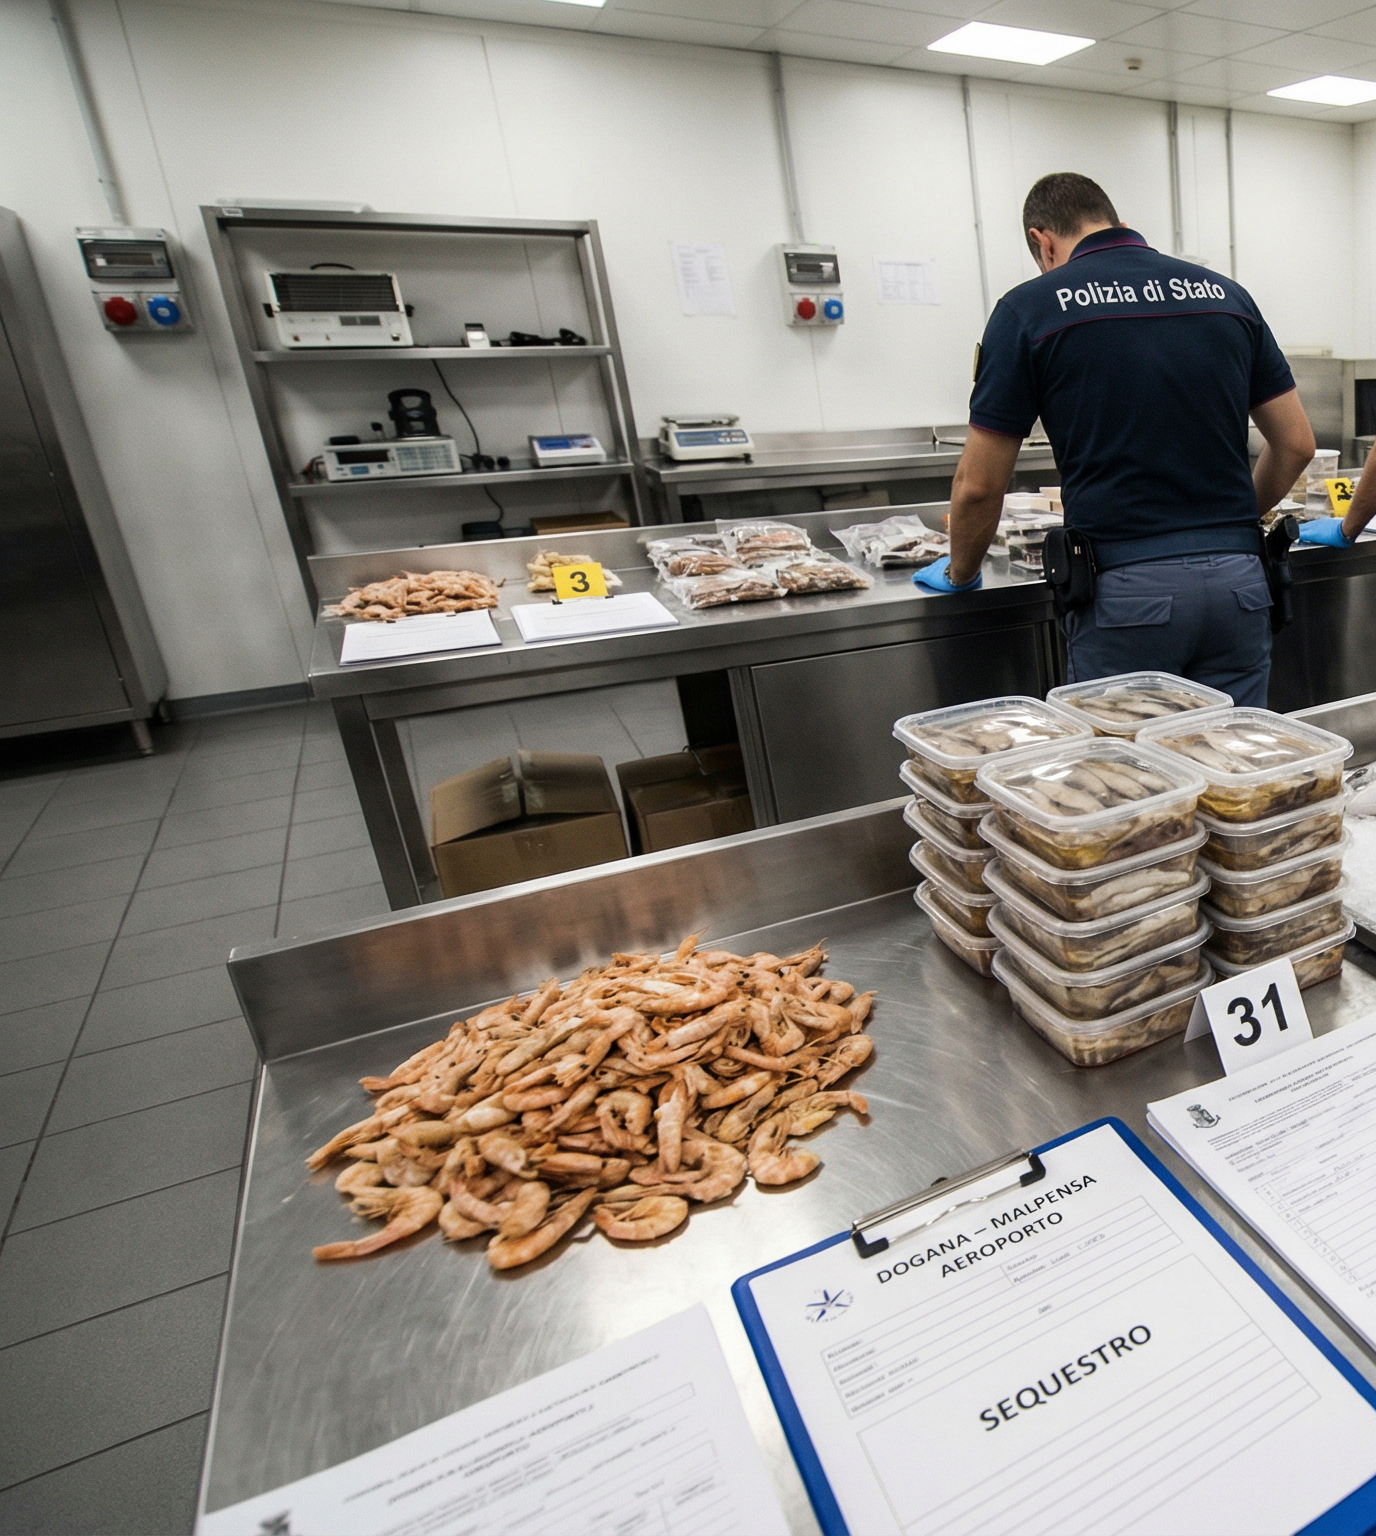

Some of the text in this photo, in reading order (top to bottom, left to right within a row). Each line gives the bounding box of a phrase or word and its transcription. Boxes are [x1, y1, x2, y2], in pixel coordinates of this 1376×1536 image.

[1056, 277, 1226, 311] Polizia di Stato
[570, 571, 590, 593] 3
[1227, 982, 1289, 1047] 31
[876, 1233, 972, 1284] DOGANA
[990, 1174, 1097, 1229] MALPENSA
[941, 1211, 1064, 1278] AEROPORTO
[979, 1325, 1151, 1432] SEQUESTRO
